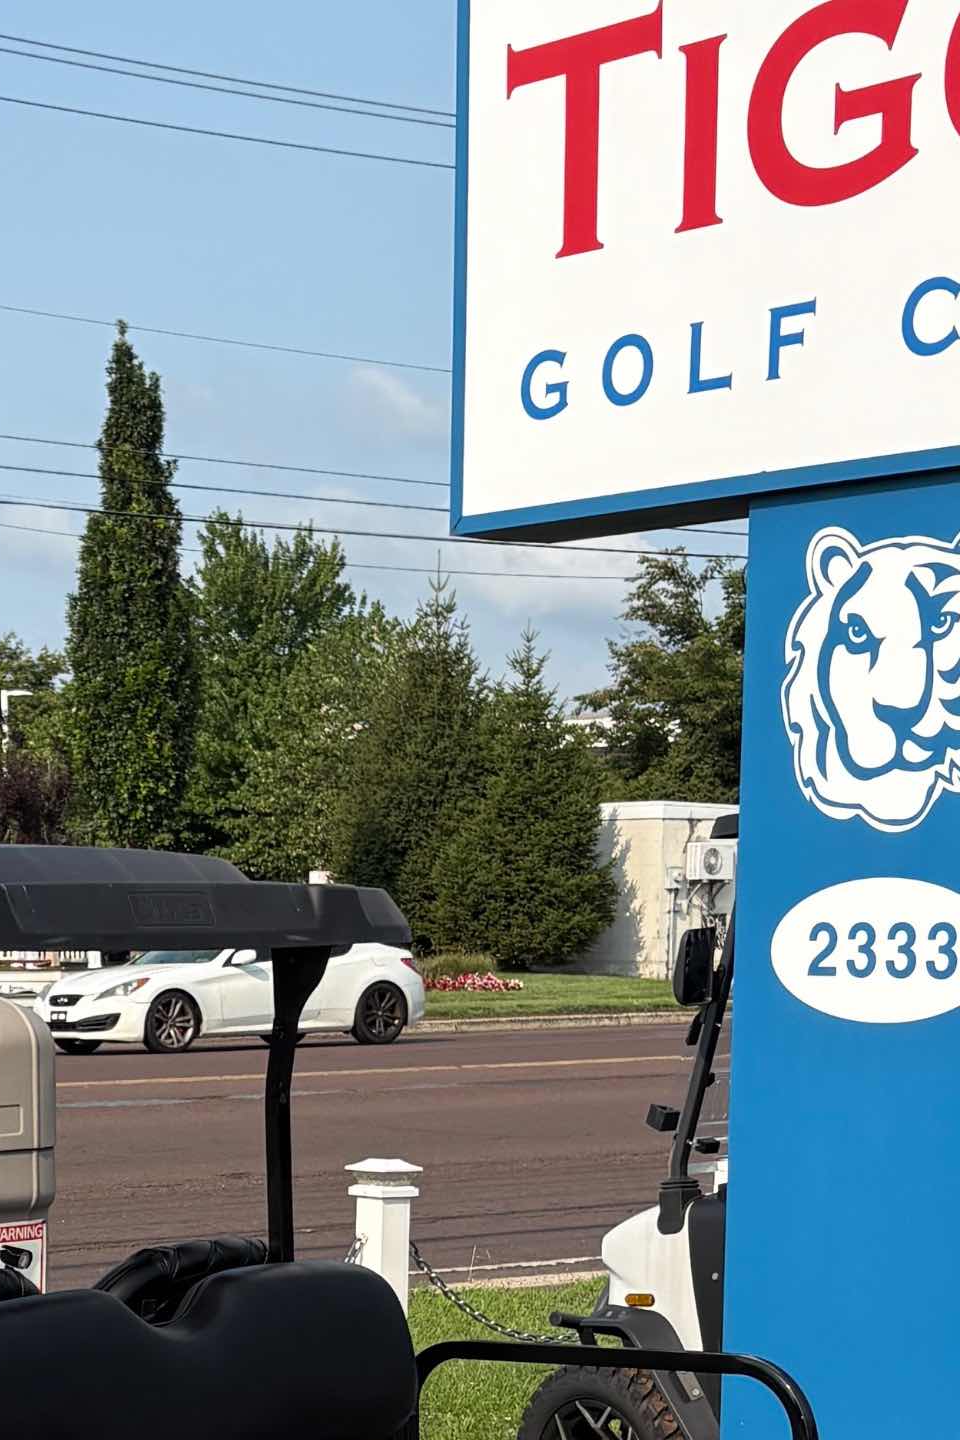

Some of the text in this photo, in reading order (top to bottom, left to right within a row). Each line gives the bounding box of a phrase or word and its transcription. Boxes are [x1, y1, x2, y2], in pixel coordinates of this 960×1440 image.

[507, 0, 960, 259] TIG
[520, 297, 817, 421] GOLF
[807, 921, 958, 980] 2333
